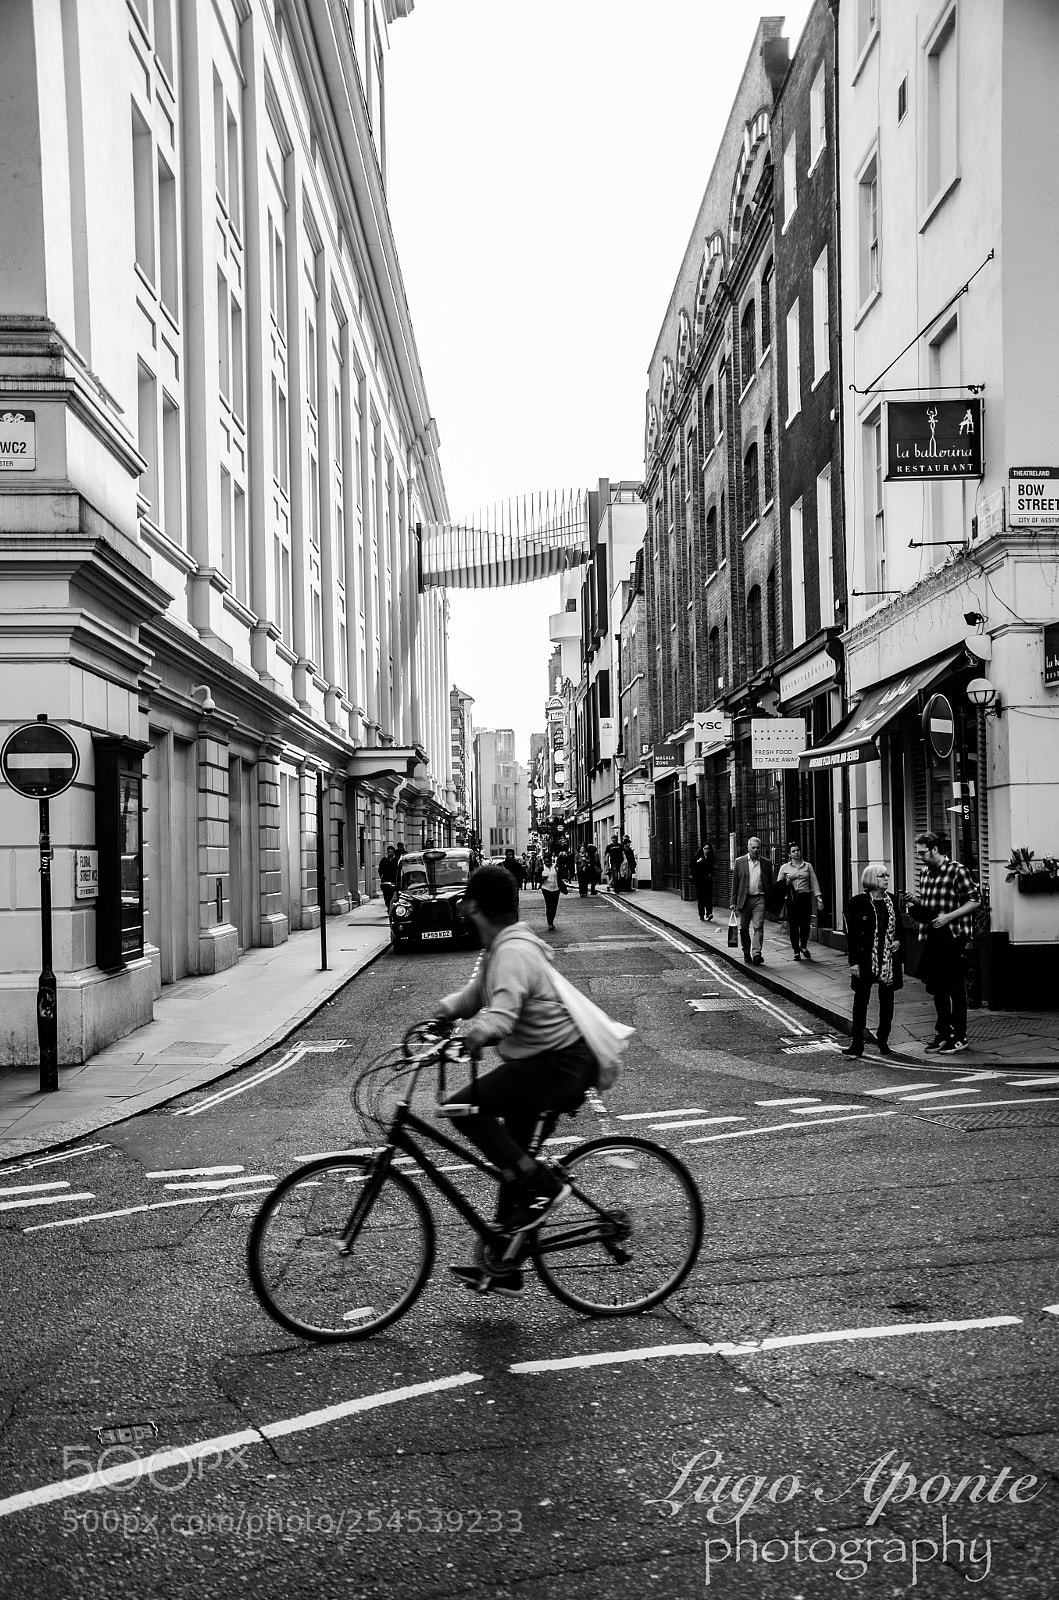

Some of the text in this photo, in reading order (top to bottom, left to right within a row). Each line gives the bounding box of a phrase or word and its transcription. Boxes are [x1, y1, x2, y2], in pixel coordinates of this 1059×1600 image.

[0, 442, 26, 453] WC2
[896, 443, 909, 458] la
[897, 464, 974, 473] RESTAURANT
[1018, 484, 1045, 496] BOW
[1017, 498, 1059, 511] STREET
[698, 721, 722, 730] YSC
